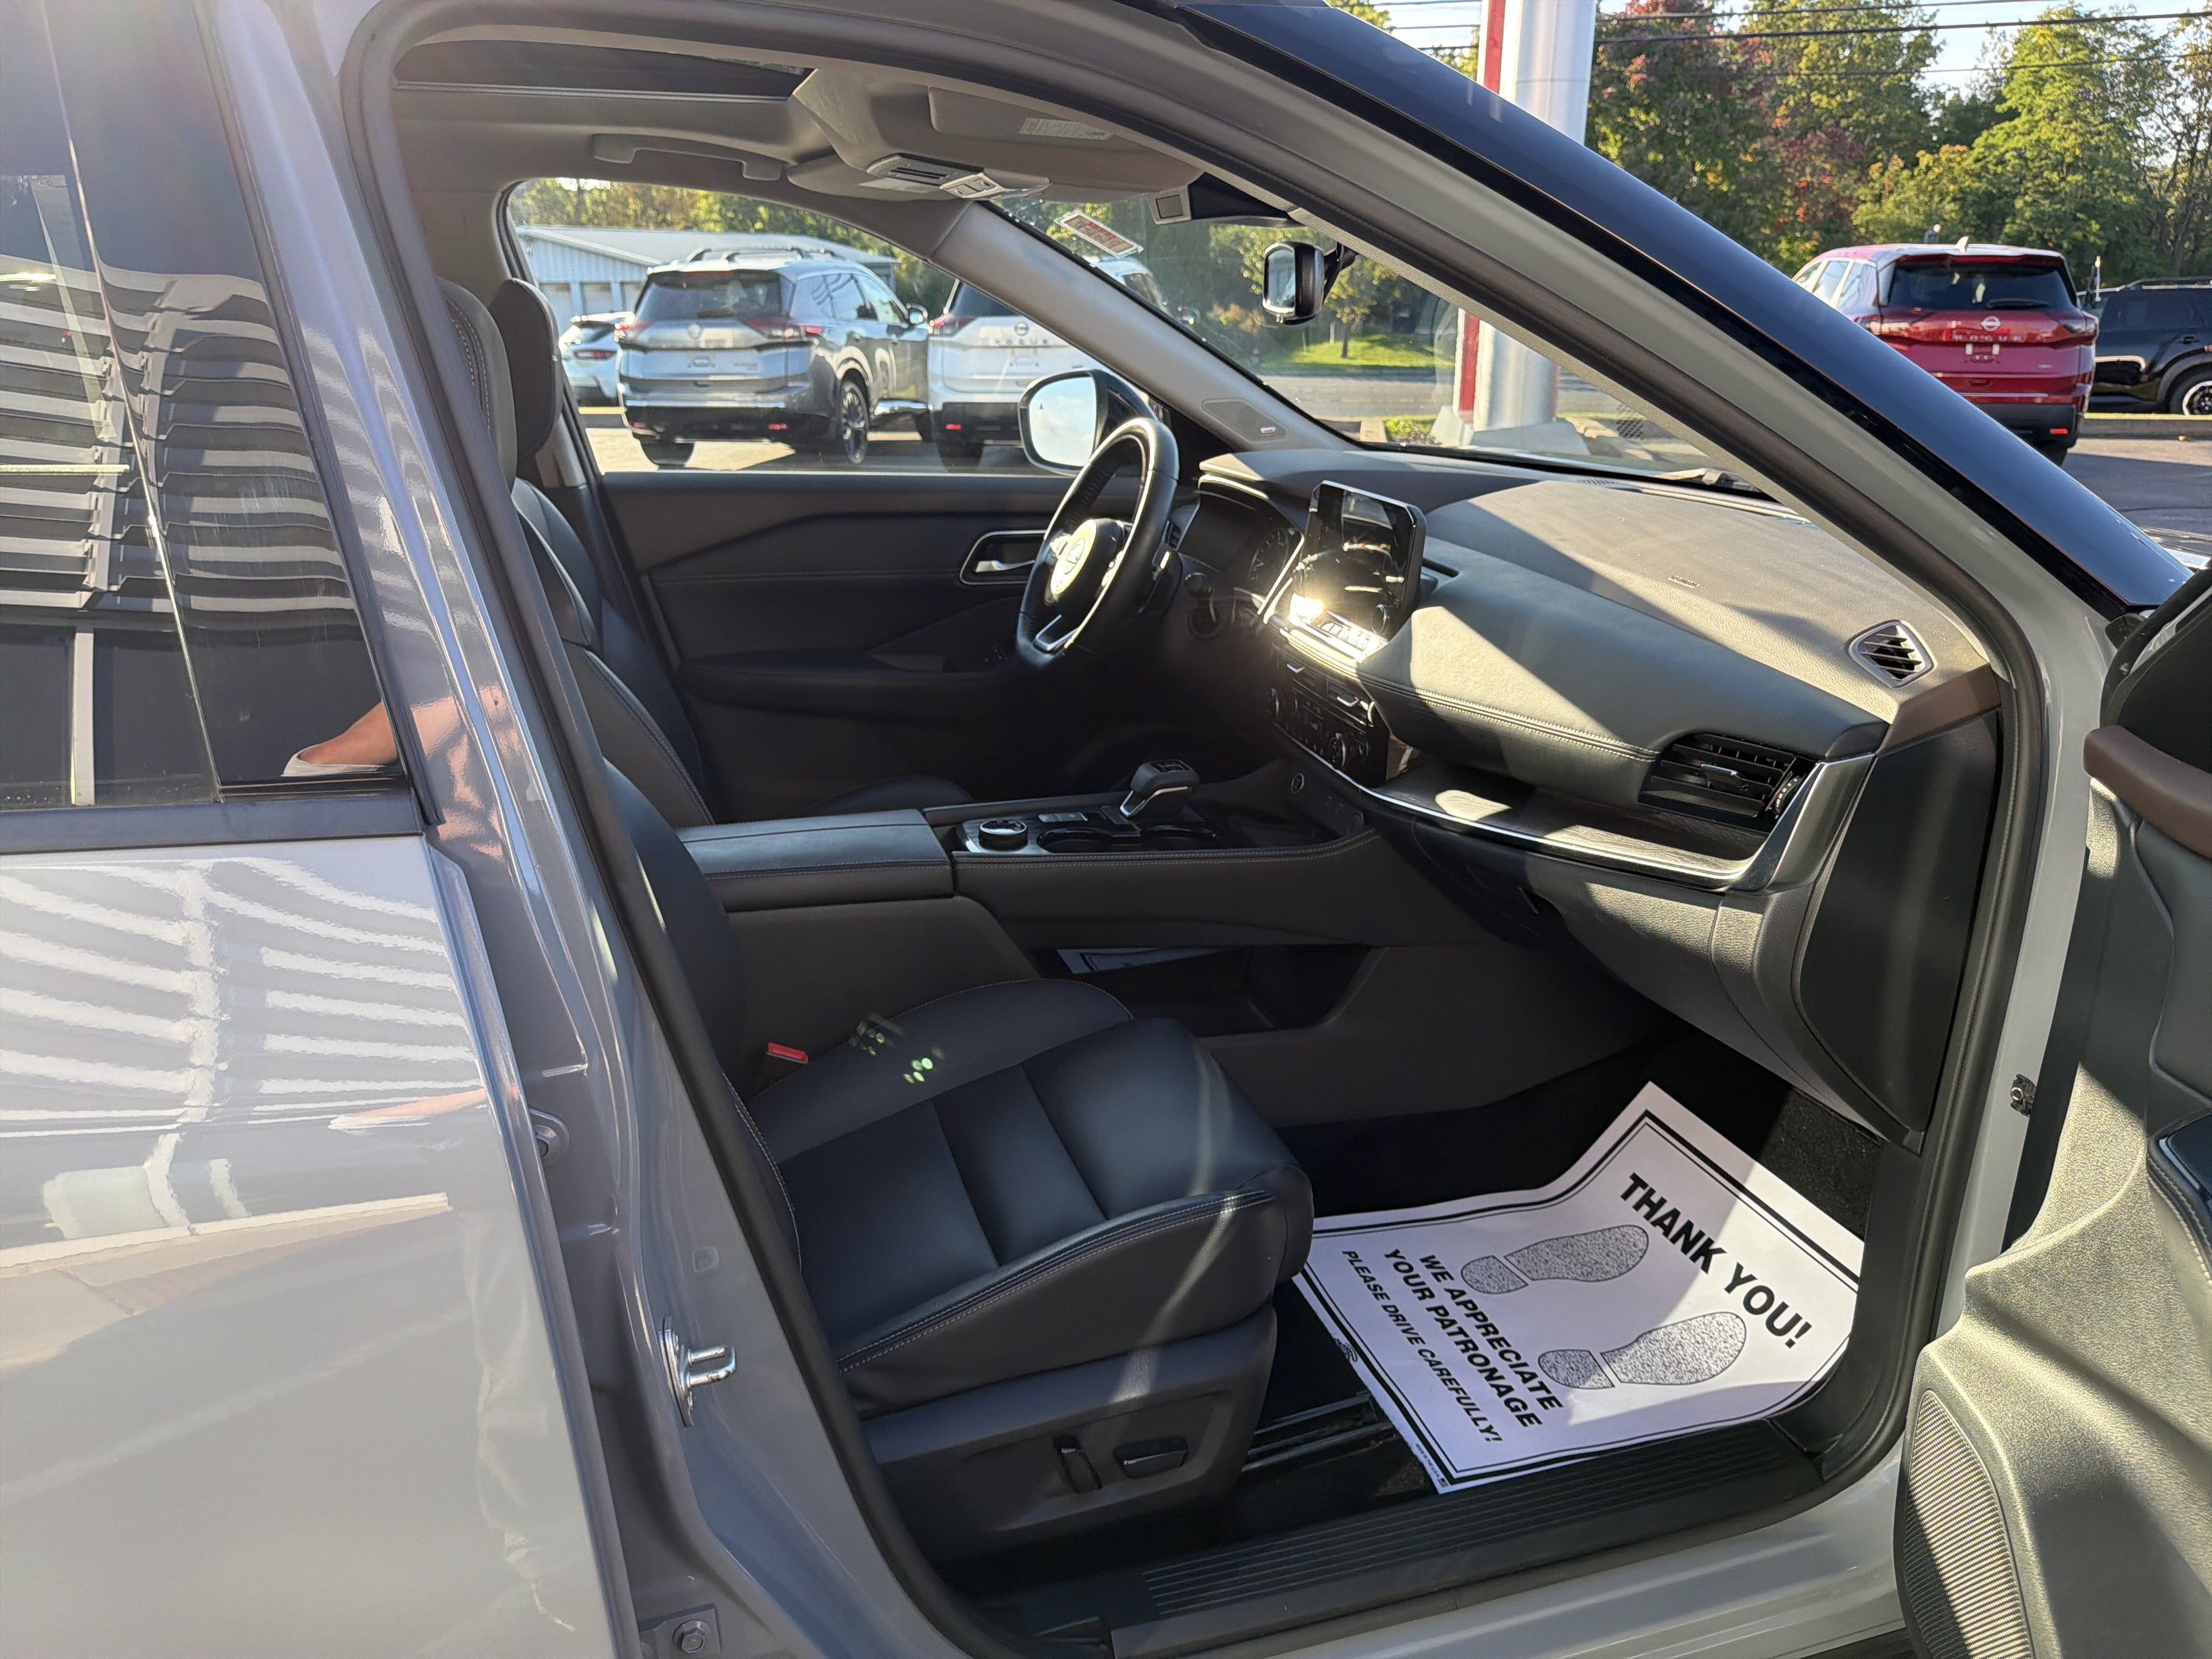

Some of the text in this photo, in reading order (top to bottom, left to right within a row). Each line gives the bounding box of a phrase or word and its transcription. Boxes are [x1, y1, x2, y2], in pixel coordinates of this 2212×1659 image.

[1342, 1251, 1390, 1301] PLEASE
[1381, 1304, 1426, 1345] DRIVE
[1418, 1348, 1503, 1442] CAREFULLY!
[1384, 1249, 1543, 1427] YOUR PATRONAGE
[1419, 1255, 1564, 1410] WE APPRECIATE
[1621, 1172, 1813, 1349] THANK YOU!
